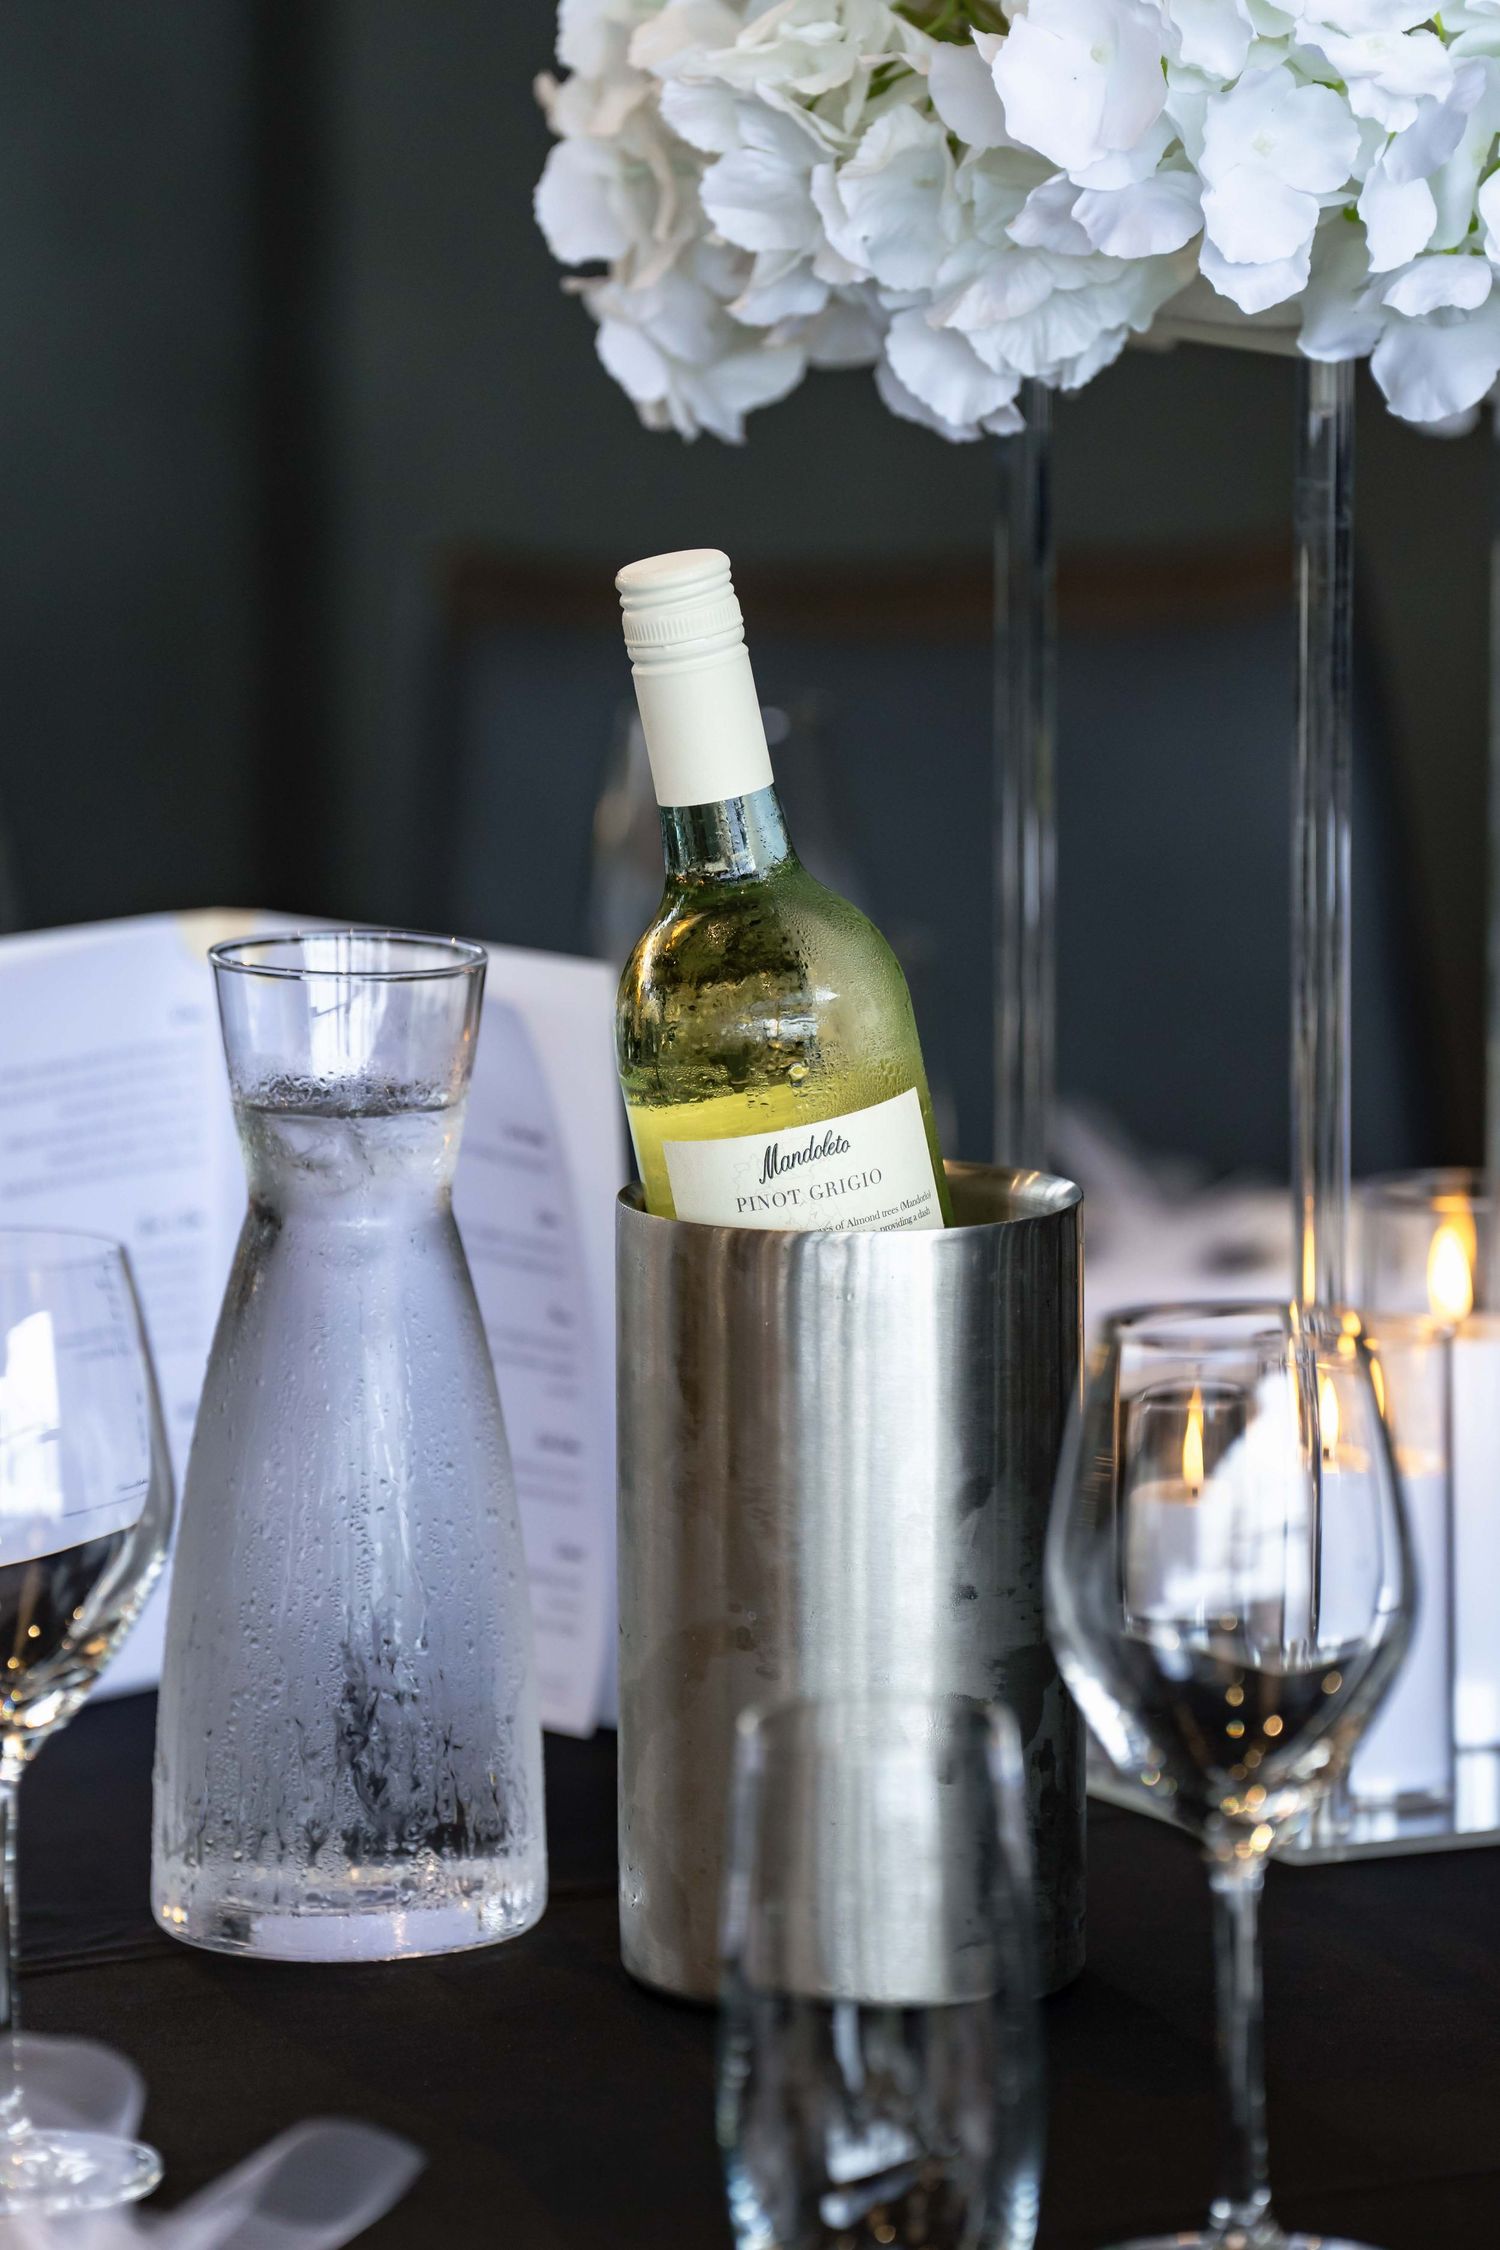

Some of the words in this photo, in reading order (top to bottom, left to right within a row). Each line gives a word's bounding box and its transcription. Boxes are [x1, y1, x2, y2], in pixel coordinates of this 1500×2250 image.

[759, 1129, 851, 1184] Mandoleto
[736, 1188, 801, 1213] PINOT
[809, 1167, 882, 1201] GRIGIO
[835, 1219, 846, 1231] of
[847, 1209, 880, 1228] Almond
[881, 1206, 899, 1218] trees
